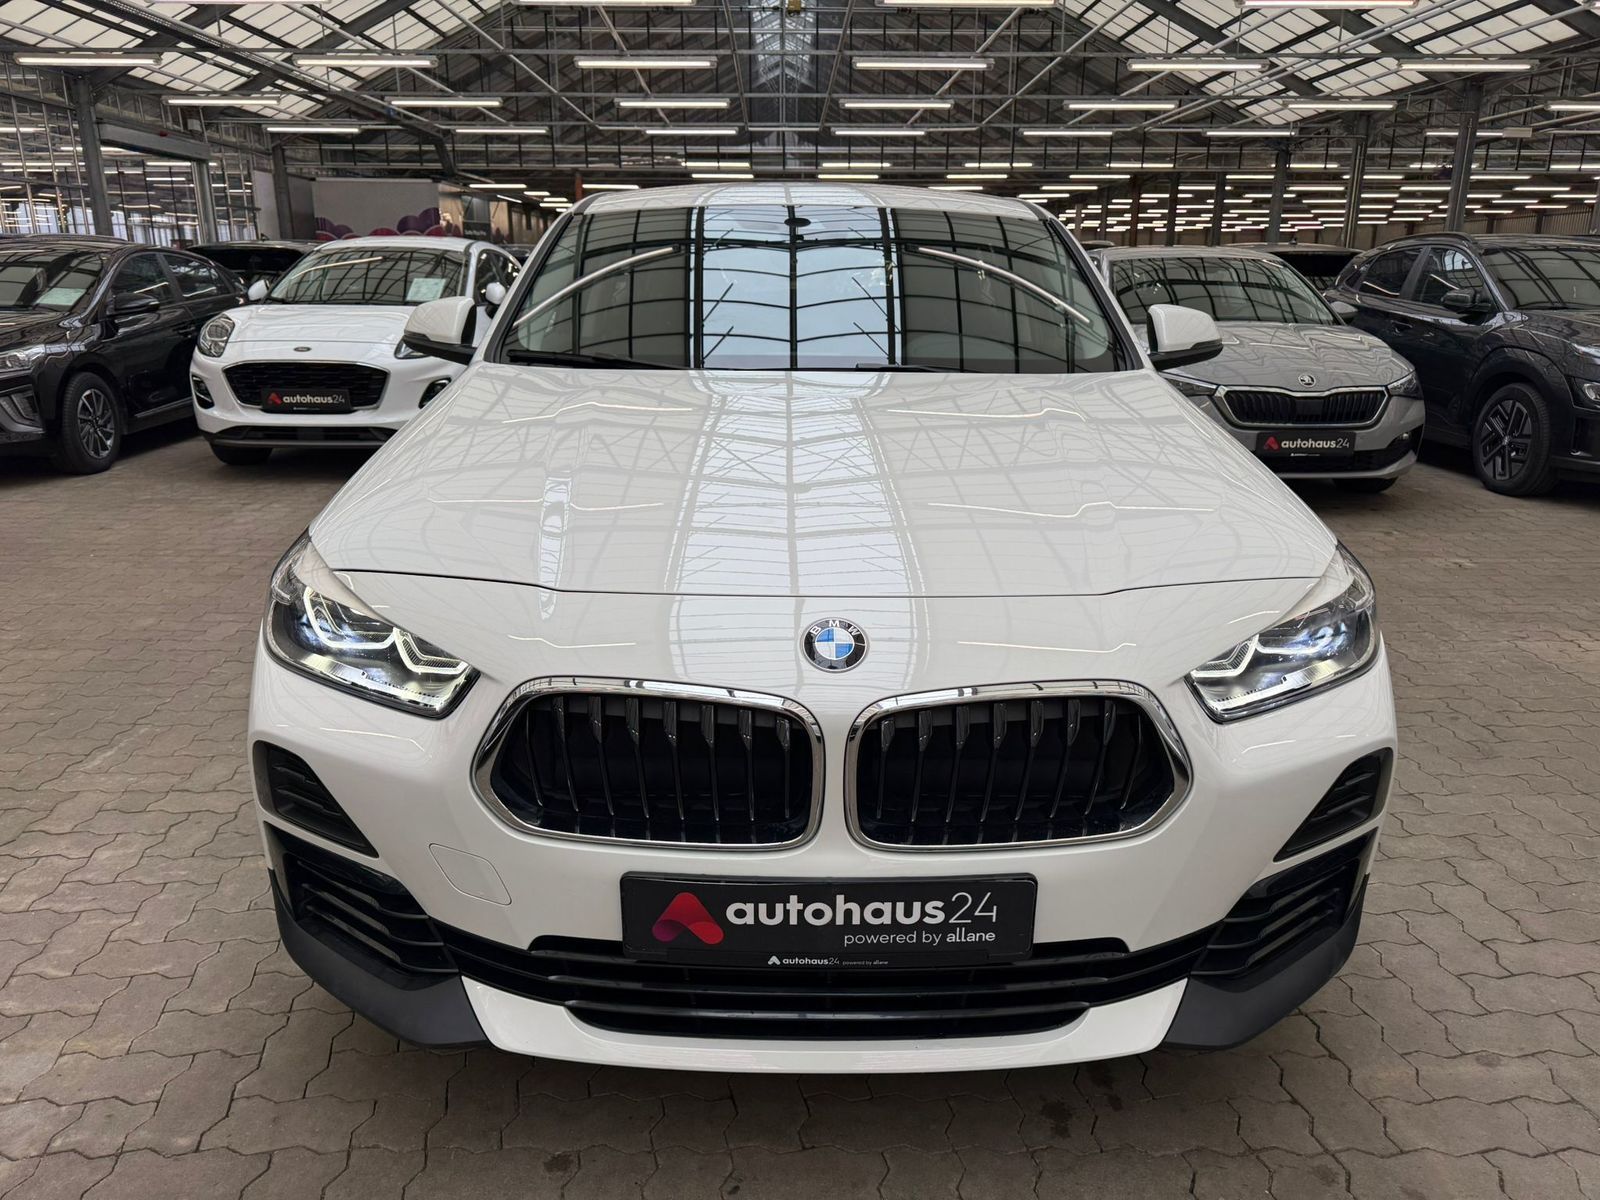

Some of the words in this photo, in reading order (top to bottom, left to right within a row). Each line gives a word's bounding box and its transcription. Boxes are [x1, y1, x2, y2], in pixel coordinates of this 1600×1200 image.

[282, 394, 345, 404] autohaus24
[1281, 438, 1350, 448] autohaus24
[810, 620, 860, 636] BMW
[725, 892, 998, 927] autohaus24
[844, 930, 917, 947] powered
[922, 930, 942, 946] by
[946, 927, 996, 943] allane
[782, 956, 840, 965] autohaus24
